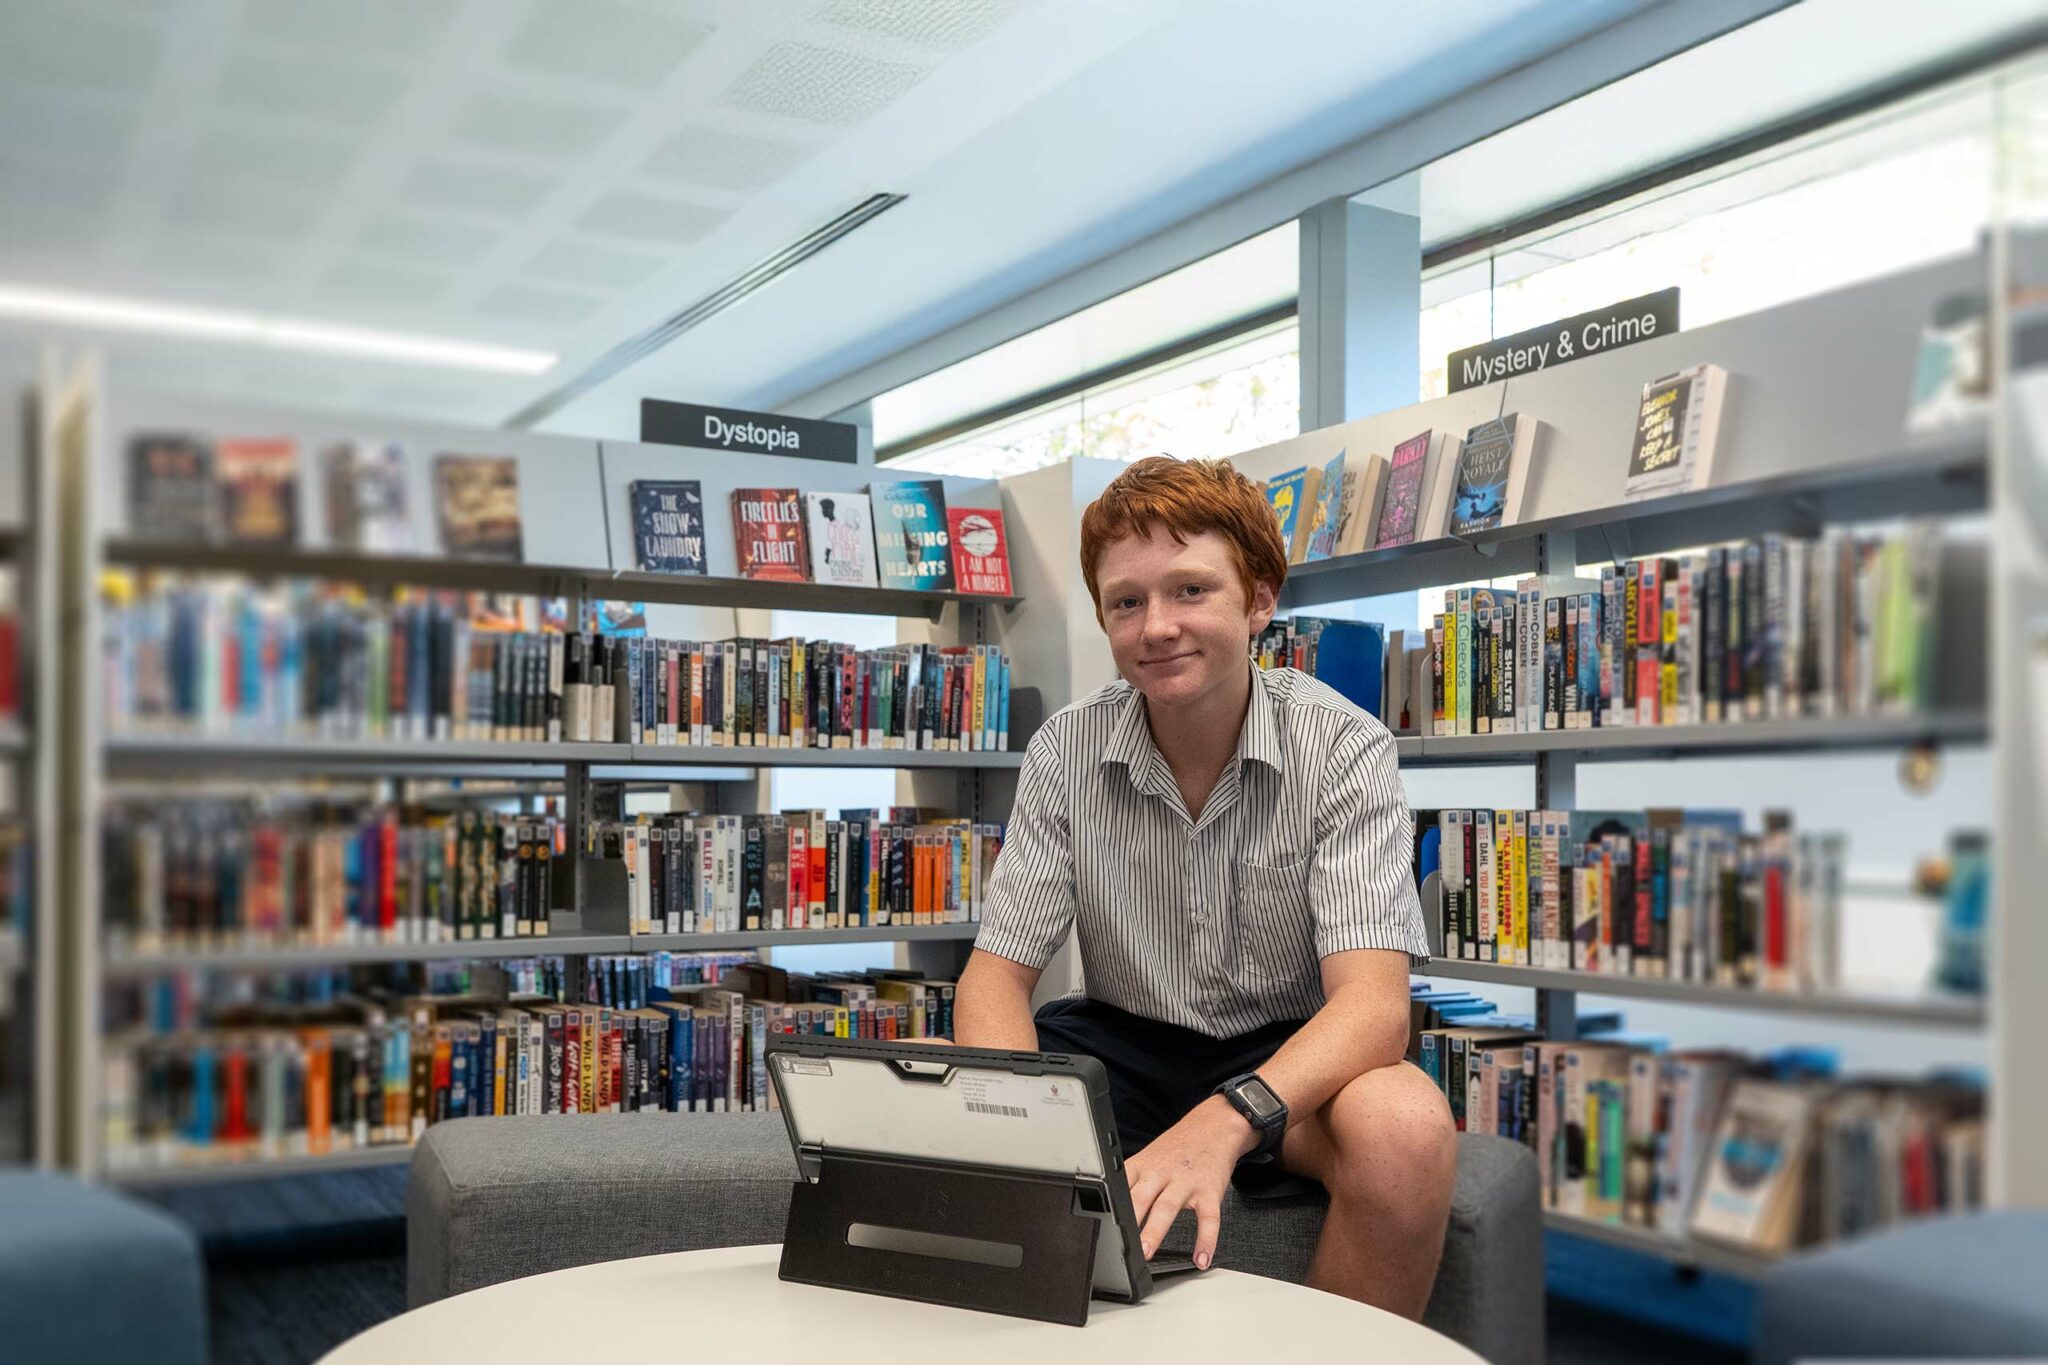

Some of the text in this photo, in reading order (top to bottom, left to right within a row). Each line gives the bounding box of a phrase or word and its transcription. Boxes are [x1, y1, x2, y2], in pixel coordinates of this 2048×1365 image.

[1463, 313, 1656, 386] Mystery & Crime
[704, 414, 800, 452] Dystopia
[1663, 433, 1673, 449] A
[1470, 447, 1502, 466] HEIST
[1643, 444, 1681, 472] SECRET
[1463, 460, 1505, 481] ROYALE
[659, 494, 678, 511] THE
[740, 501, 800, 523] FIREFLIES
[892, 503, 928, 519] OUR
[645, 536, 701, 559] LAUNDRY
[752, 541, 796, 564] FLIGHT
[885, 561, 947, 578] HEARTS
[968, 557, 984, 575] AM
[985, 557, 1002, 575] NOT
[963, 575, 1007, 593] A NUMBER
[1445, 625, 1455, 688] Cleeves
[1458, 625, 1469, 689] Cleeves
[1531, 622, 1540, 666] COBEN
[1504, 649, 1513, 713] SHELTER
[975, 682, 983, 731] KILLABLE
[1565, 684, 1577, 711] WIN
[703, 840, 712, 870] ILLER
[1504, 860, 1511, 872] IN
[1543, 851, 1558, 884] CARTE
[727, 871, 735, 894] WINTER
[1480, 842, 1489, 937] DAHL YOU ARE NEXT
[1449, 889, 1458, 912] STATE
[1504, 893, 1512, 937] MIRROR
[583, 1039, 592, 1072] WILD
[599, 1036, 609, 1107] WILD LANDS
[582, 1075, 592, 1113] LANDS
